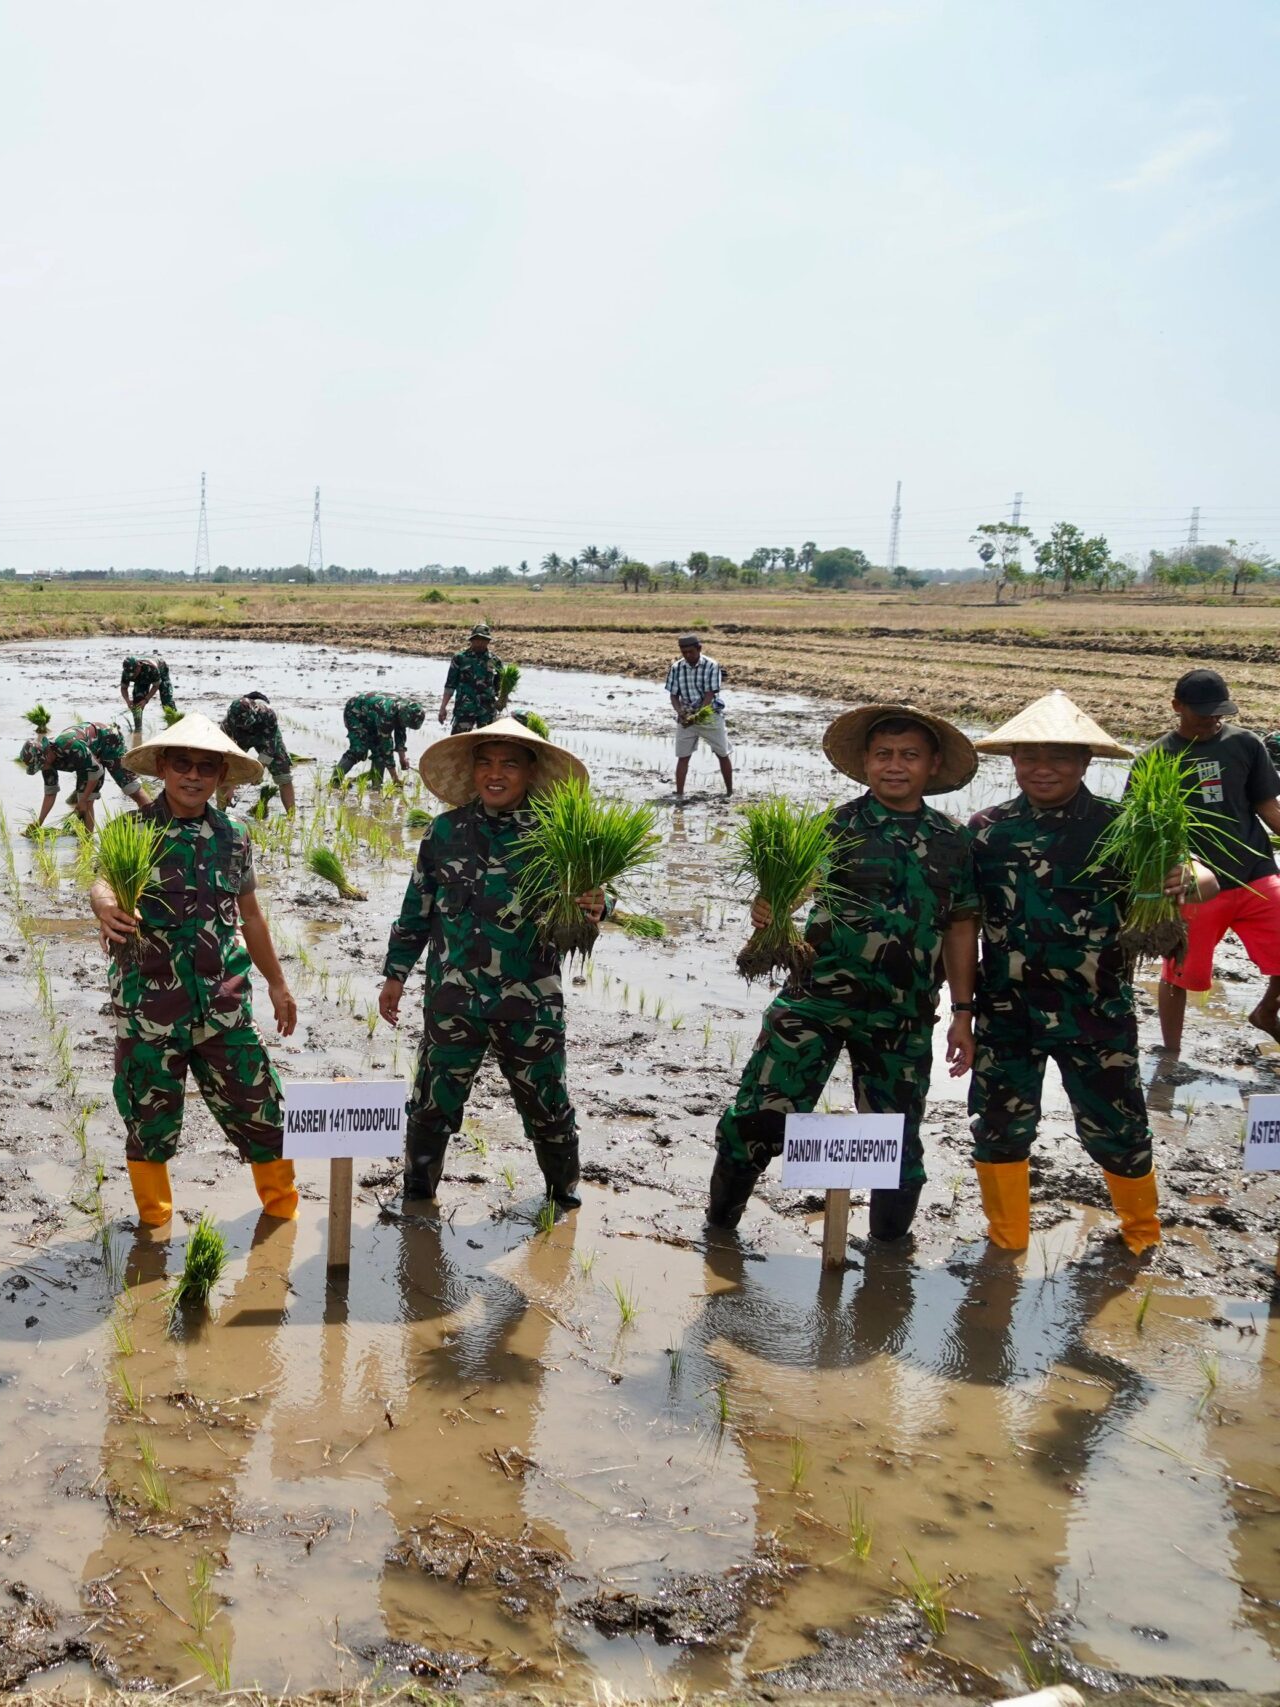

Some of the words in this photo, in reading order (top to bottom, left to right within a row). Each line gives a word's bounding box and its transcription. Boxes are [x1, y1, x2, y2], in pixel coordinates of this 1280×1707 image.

[287, 1109, 327, 1133] KASREM
[329, 1107, 401, 1132] 141/TODDOPULI
[787, 1139, 822, 1162] DANDIM
[824, 1139, 898, 1163] 1425/JENEPONTO
